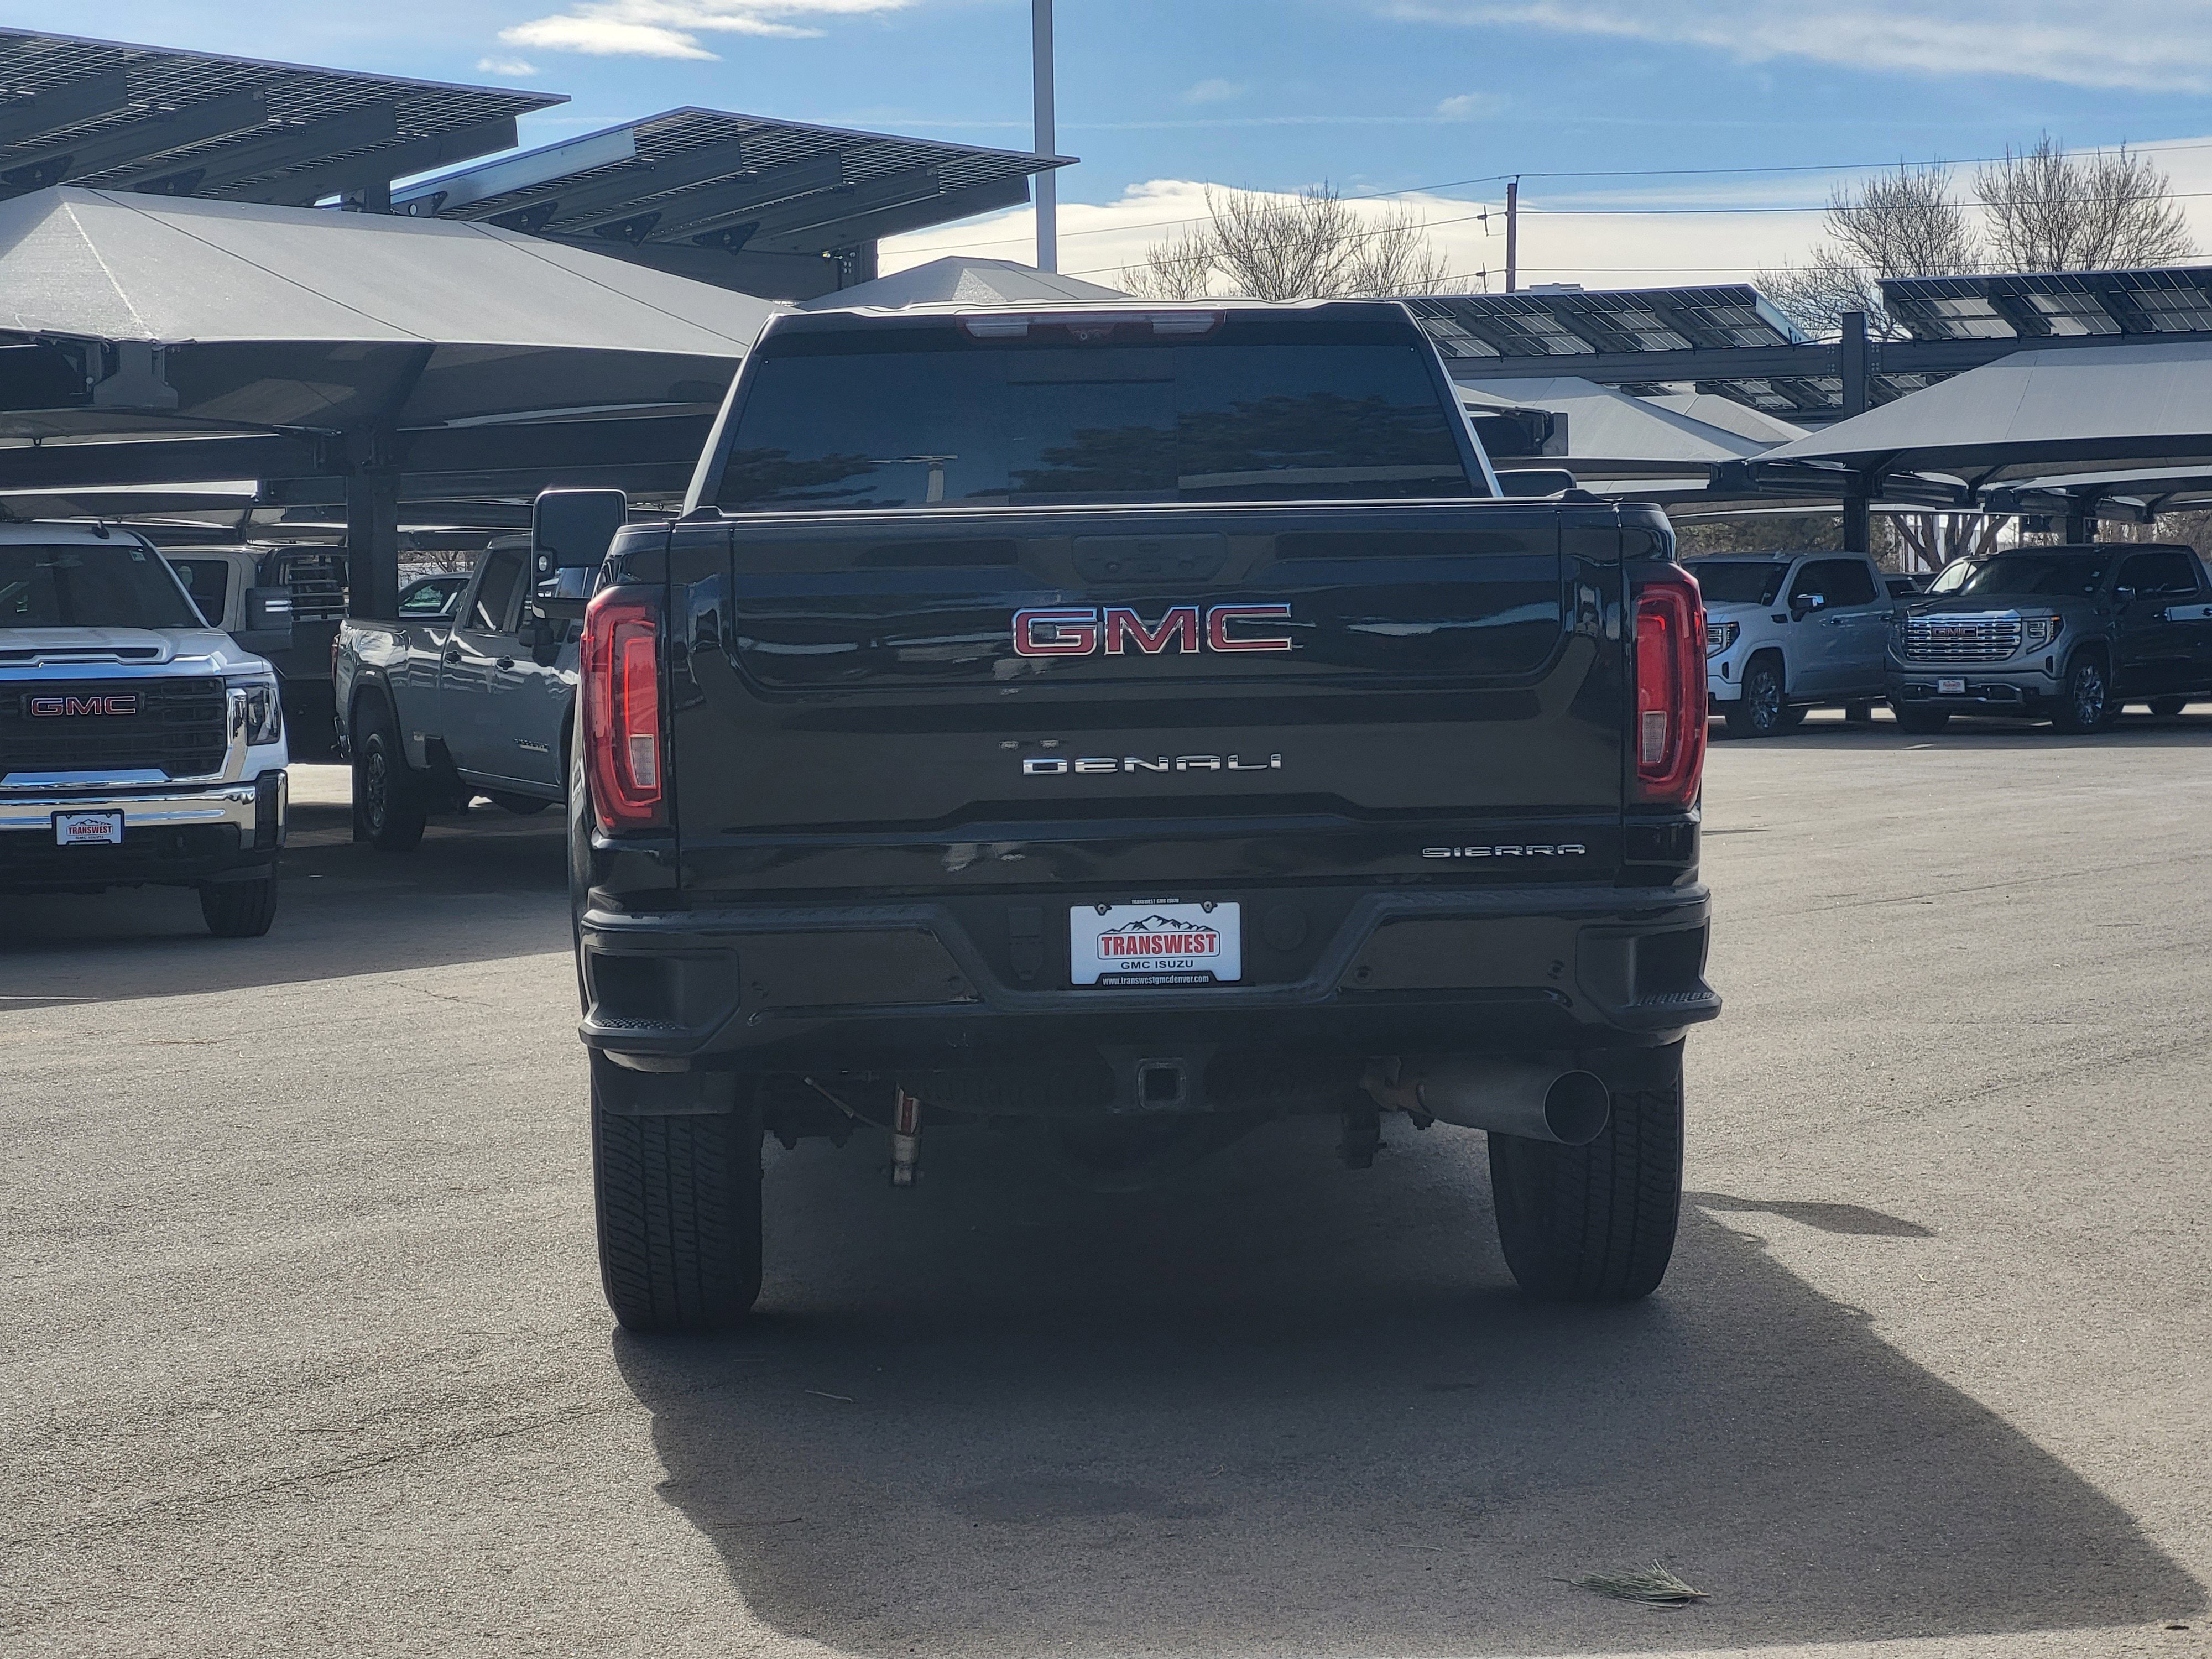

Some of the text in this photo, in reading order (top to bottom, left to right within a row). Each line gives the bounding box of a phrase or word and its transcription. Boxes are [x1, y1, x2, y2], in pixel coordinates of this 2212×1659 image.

[1011, 603, 1292, 657] GMC
[1932, 627, 1975, 637] GMC
[32, 696, 136, 716] GMC
[1022, 753, 1282, 775] DENALI
[67, 826, 112, 834] TRANSWEST
[1422, 844, 1585, 858] SIERRA
[1102, 934, 1217, 956] TRANSWEST
[1121, 960, 1193, 969] GMC ISUZU
[1103, 975, 1209, 985] www.transwestgmcdenver.com
